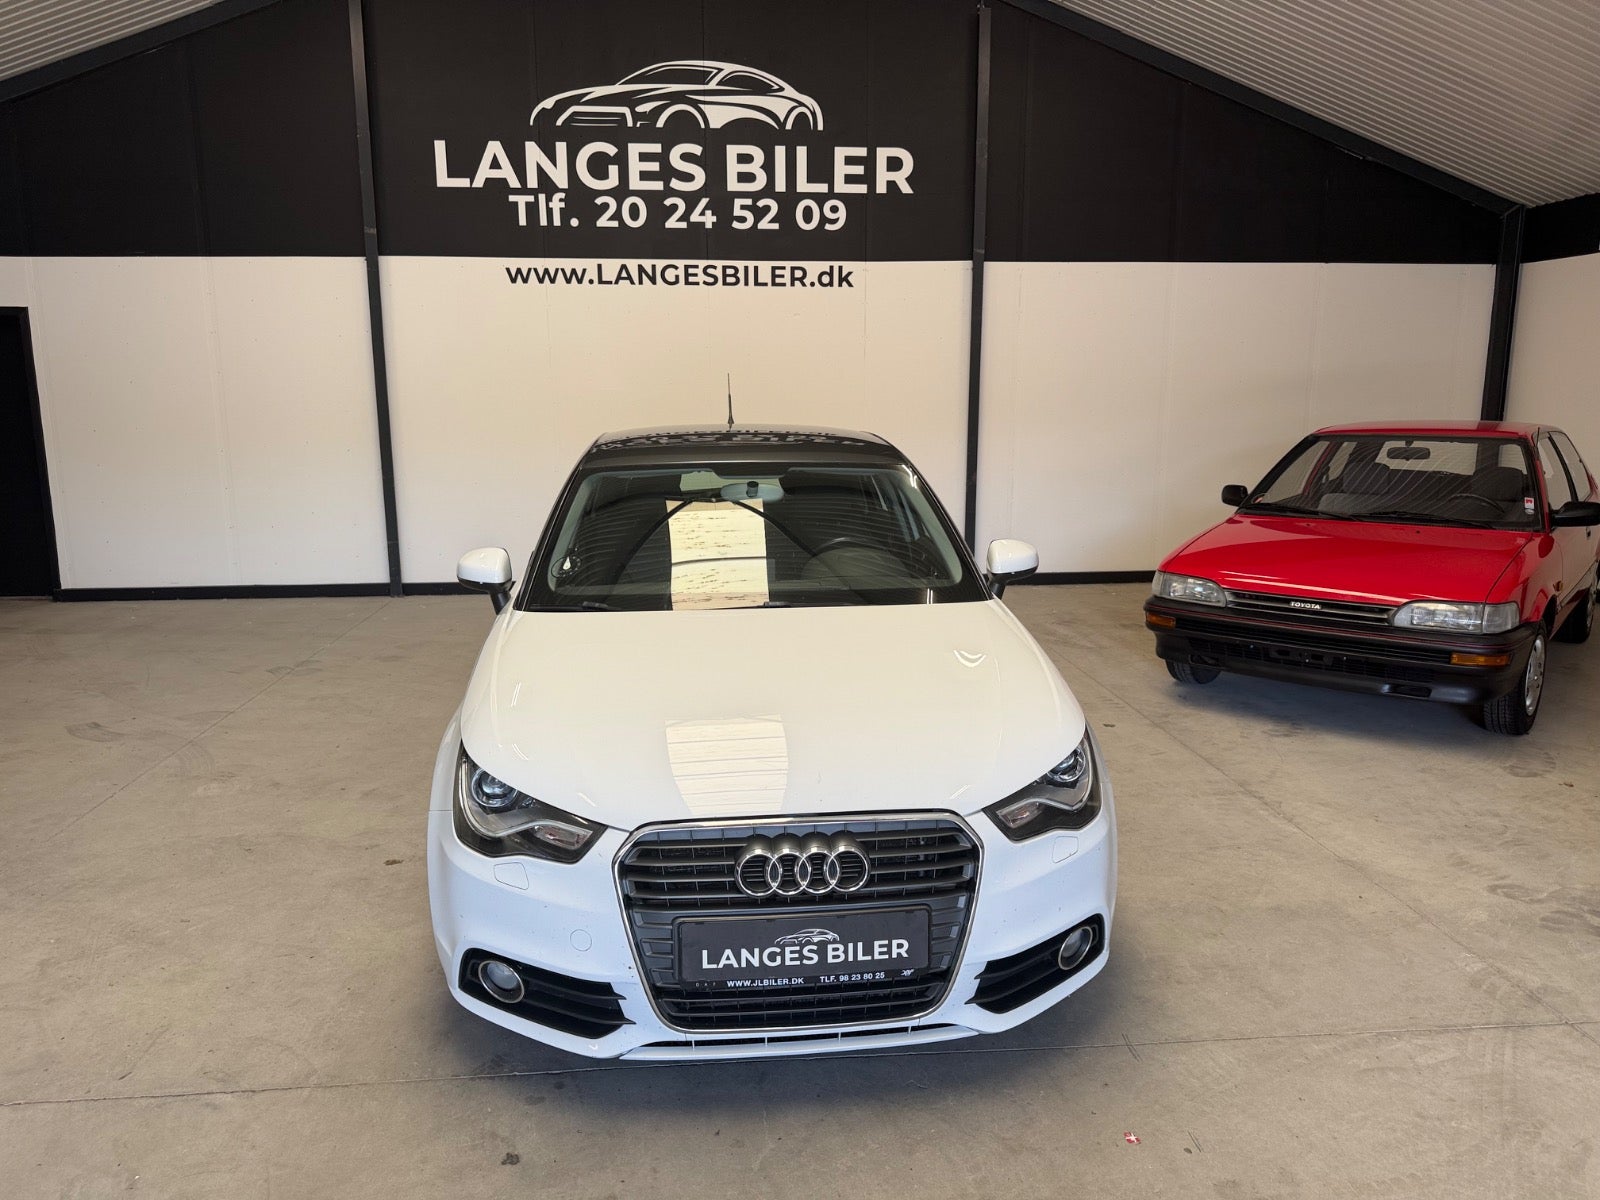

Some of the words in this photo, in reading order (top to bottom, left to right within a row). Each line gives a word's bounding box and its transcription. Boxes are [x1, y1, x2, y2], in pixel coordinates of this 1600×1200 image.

[433, 139, 706, 192] LANGES
[725, 144, 914, 194] BILER
[508, 192, 580, 228] Tlf.
[594, 195, 648, 228] 20
[663, 196, 717, 229] 24
[731, 197, 780, 230] 52
[795, 198, 847, 231] 09
[505, 263, 854, 288] www.LANGESBILER.dk
[1290, 601, 1321, 609] TOYOTA
[702, 944, 819, 969] LANGES
[827, 939, 909, 964] BILER
[726, 977, 805, 988] WWW.JLBILER.DK
[819, 975, 837, 983] TLF.
[839, 974, 849, 982] 98
[851, 973, 861, 981] 23
[863, 972, 873, 980] 80
[875, 971, 885, 979] 25
